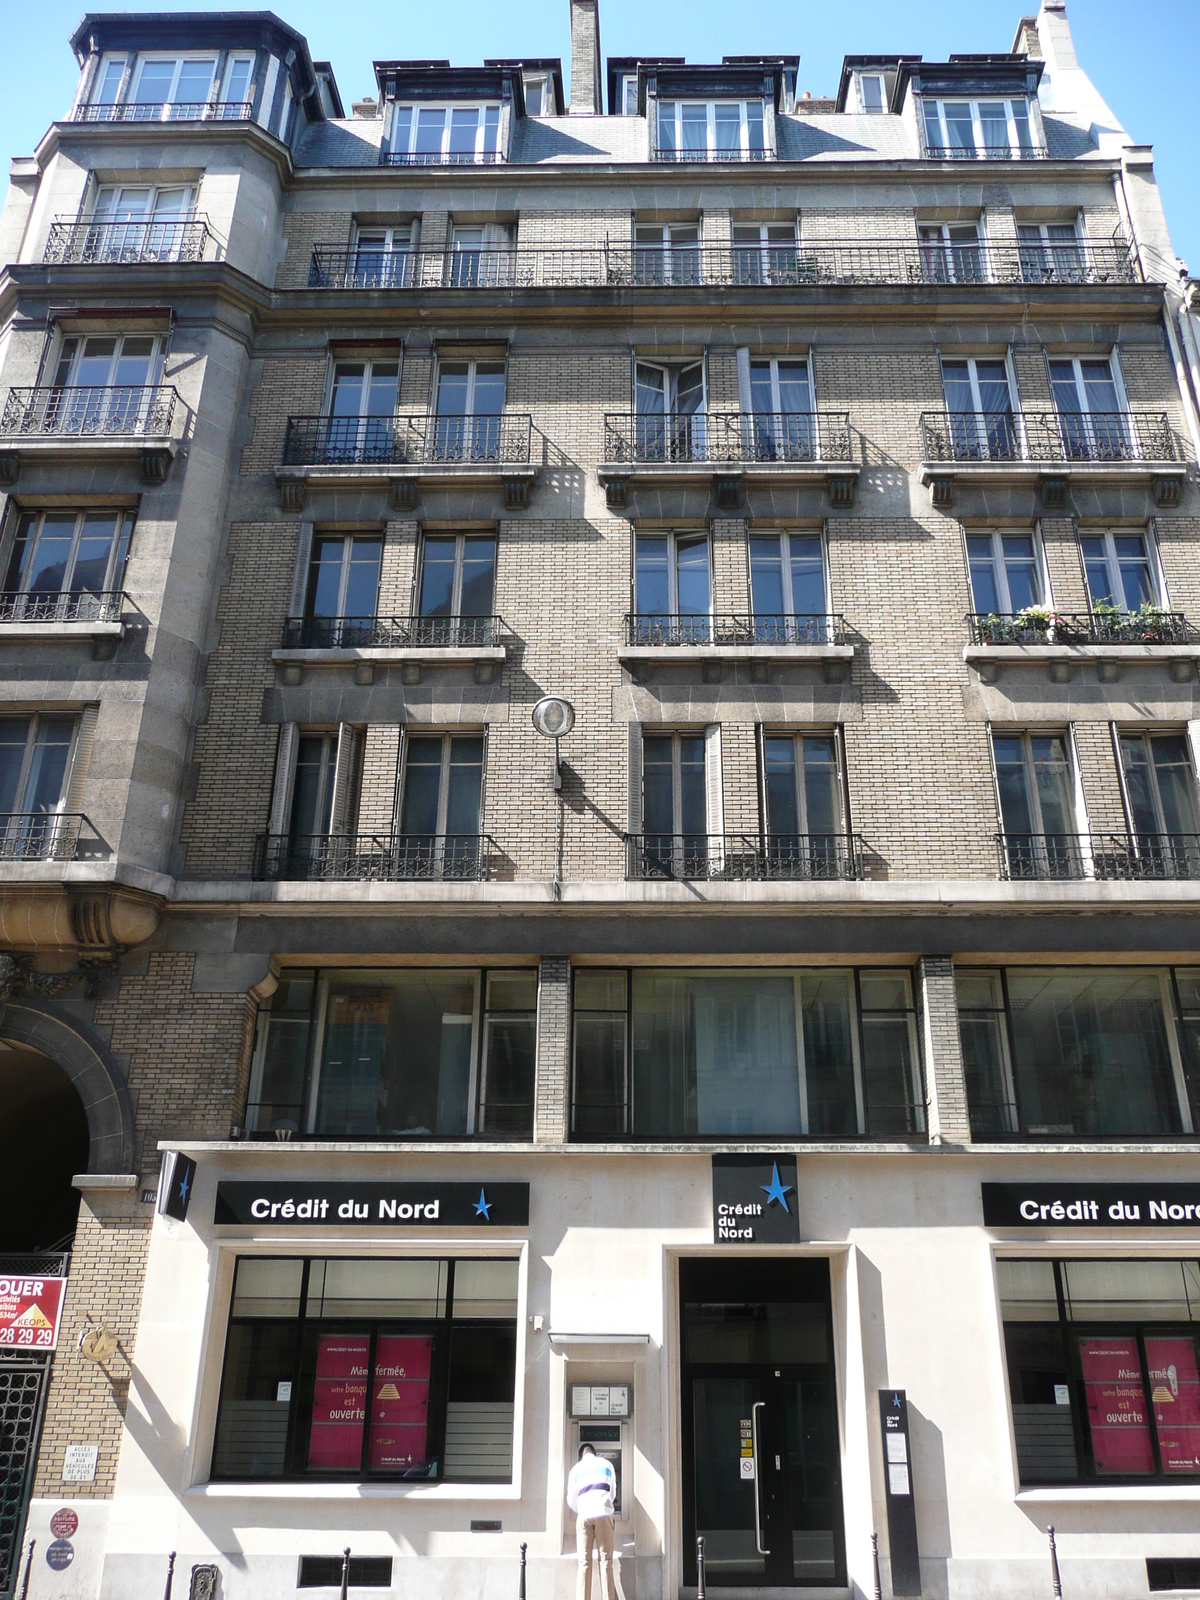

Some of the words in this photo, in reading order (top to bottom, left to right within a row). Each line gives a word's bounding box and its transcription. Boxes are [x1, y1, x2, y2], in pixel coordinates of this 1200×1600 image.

[250, 1198, 330, 1219] Crédit
[338, 1199, 369, 1219] du
[378, 1199, 440, 1219] Nord
[718, 1204, 762, 1215] Crédit
[1019, 1199, 1100, 1221] Crédit
[1107, 1200, 1141, 1221] du
[718, 1216, 736, 1227] du
[718, 1227, 753, 1238] Nord
[0, 1328, 14, 1343] 28
[18, 1329, 33, 1344] 29
[37, 1329, 52, 1345] 29
[350, 1365, 369, 1376] Mêm
[345, 1383, 367, 1397] banqu
[1115, 1386, 1143, 1400] banque
[344, 1397, 356, 1407] est
[1118, 1400, 1130, 1409] est
[329, 1408, 365, 1420] ouverte
[1106, 1411, 1143, 1423] ouverte
[593, 1429, 619, 1438] service
